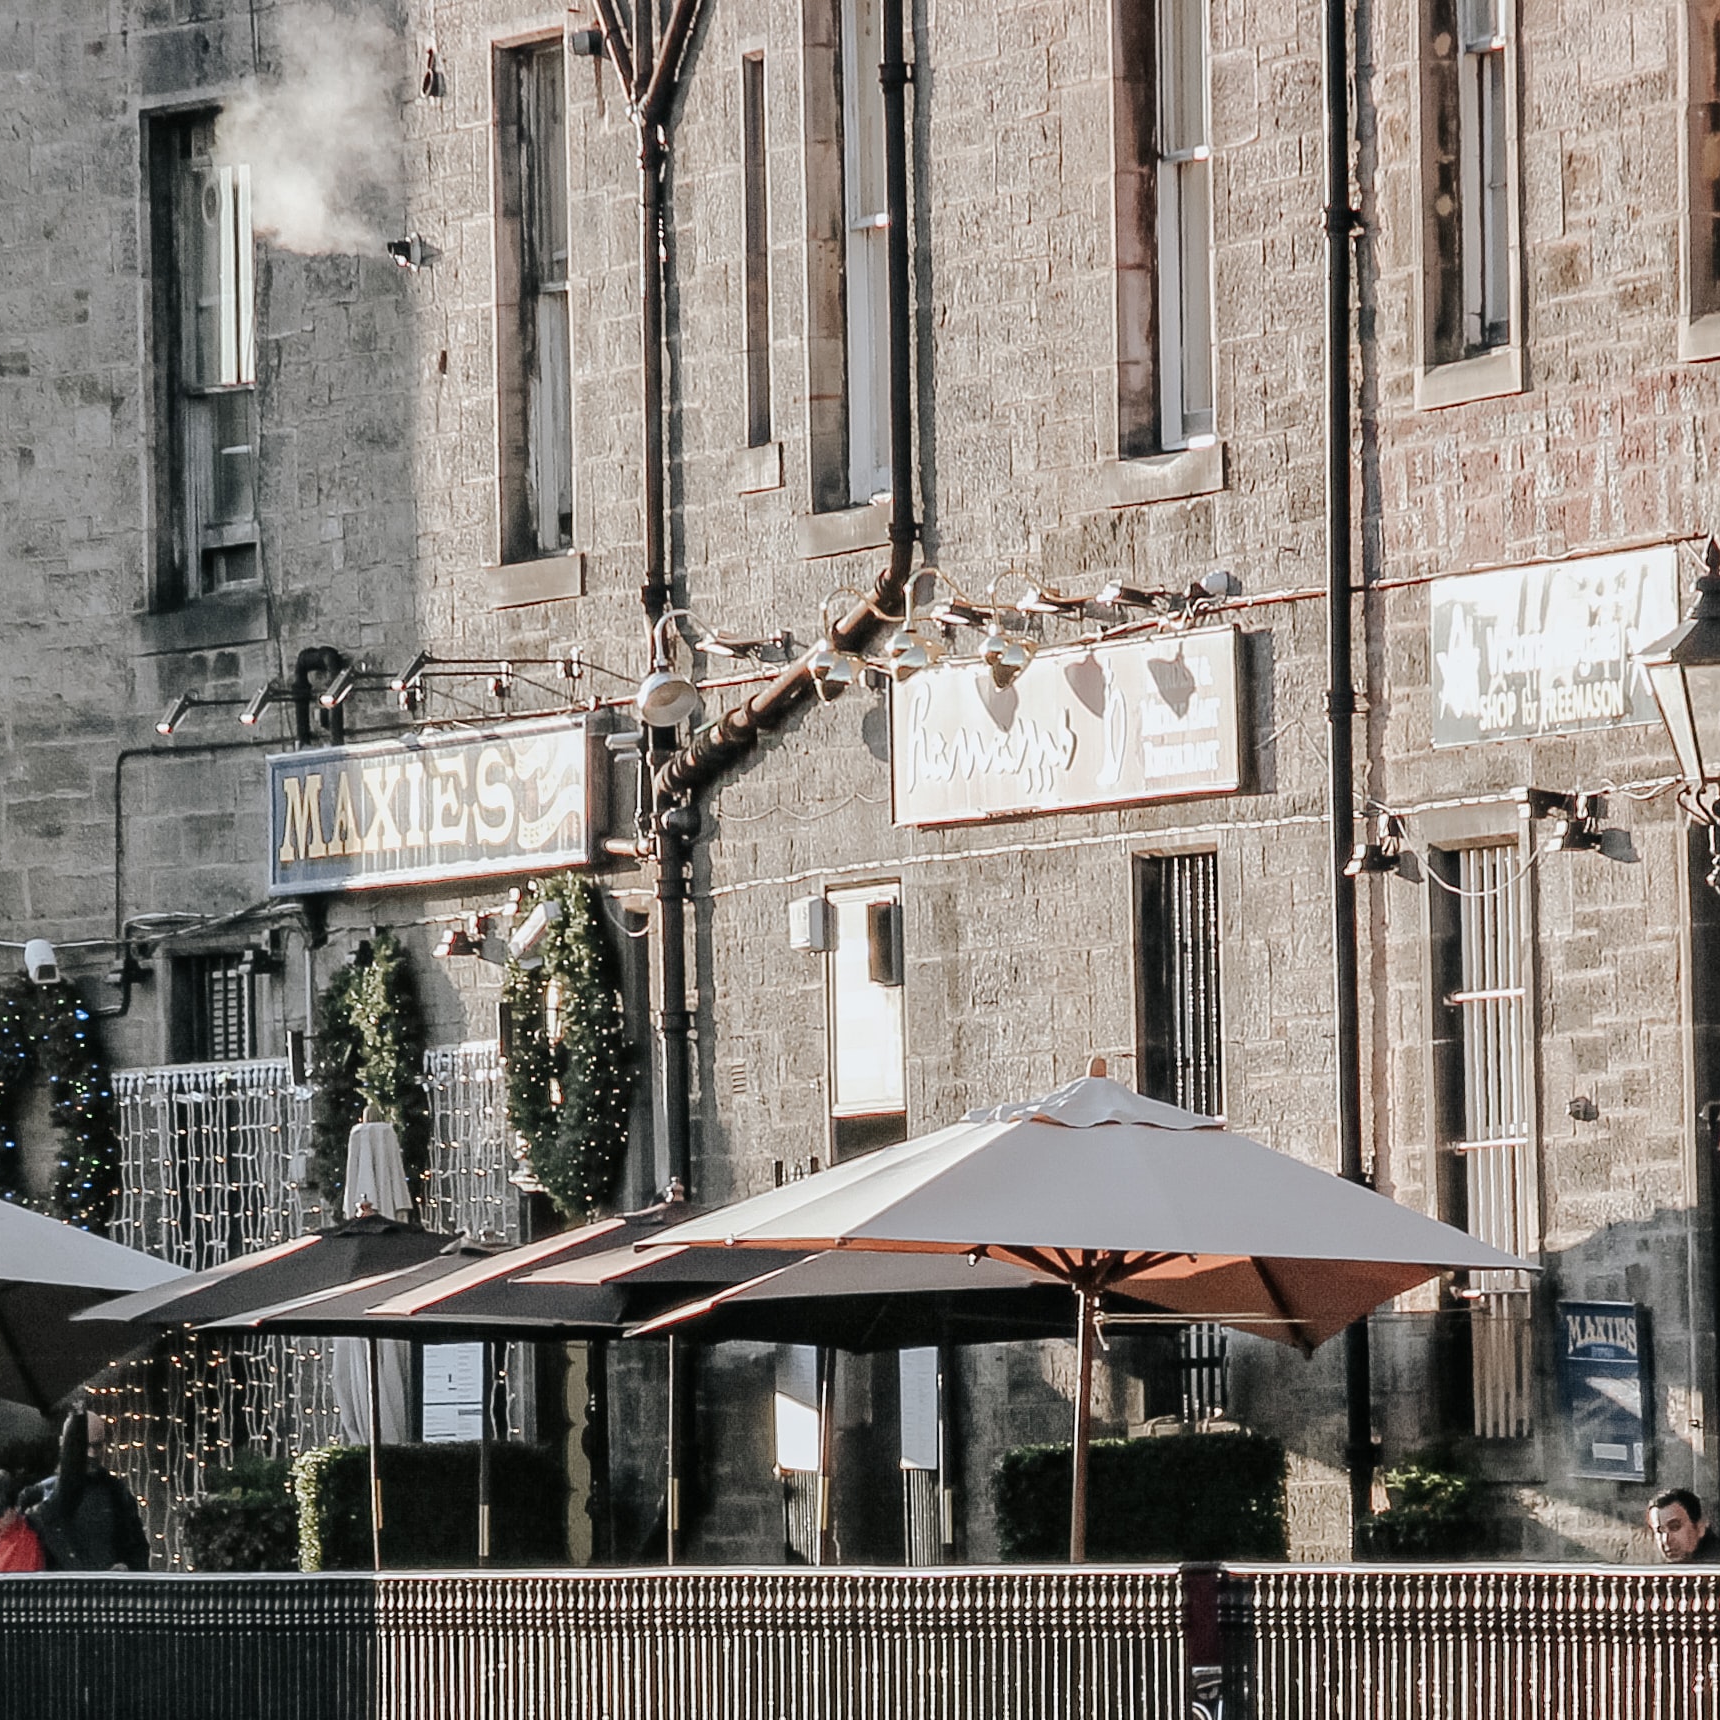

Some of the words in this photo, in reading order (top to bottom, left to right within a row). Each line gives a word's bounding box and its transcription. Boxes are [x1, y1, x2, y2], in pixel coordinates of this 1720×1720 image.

[1480, 691, 1517, 731] SHOP
[1522, 687, 1539, 725] for
[280, 747, 515, 862] MAXIES
[1566, 1314, 1637, 1356] MAXIES
